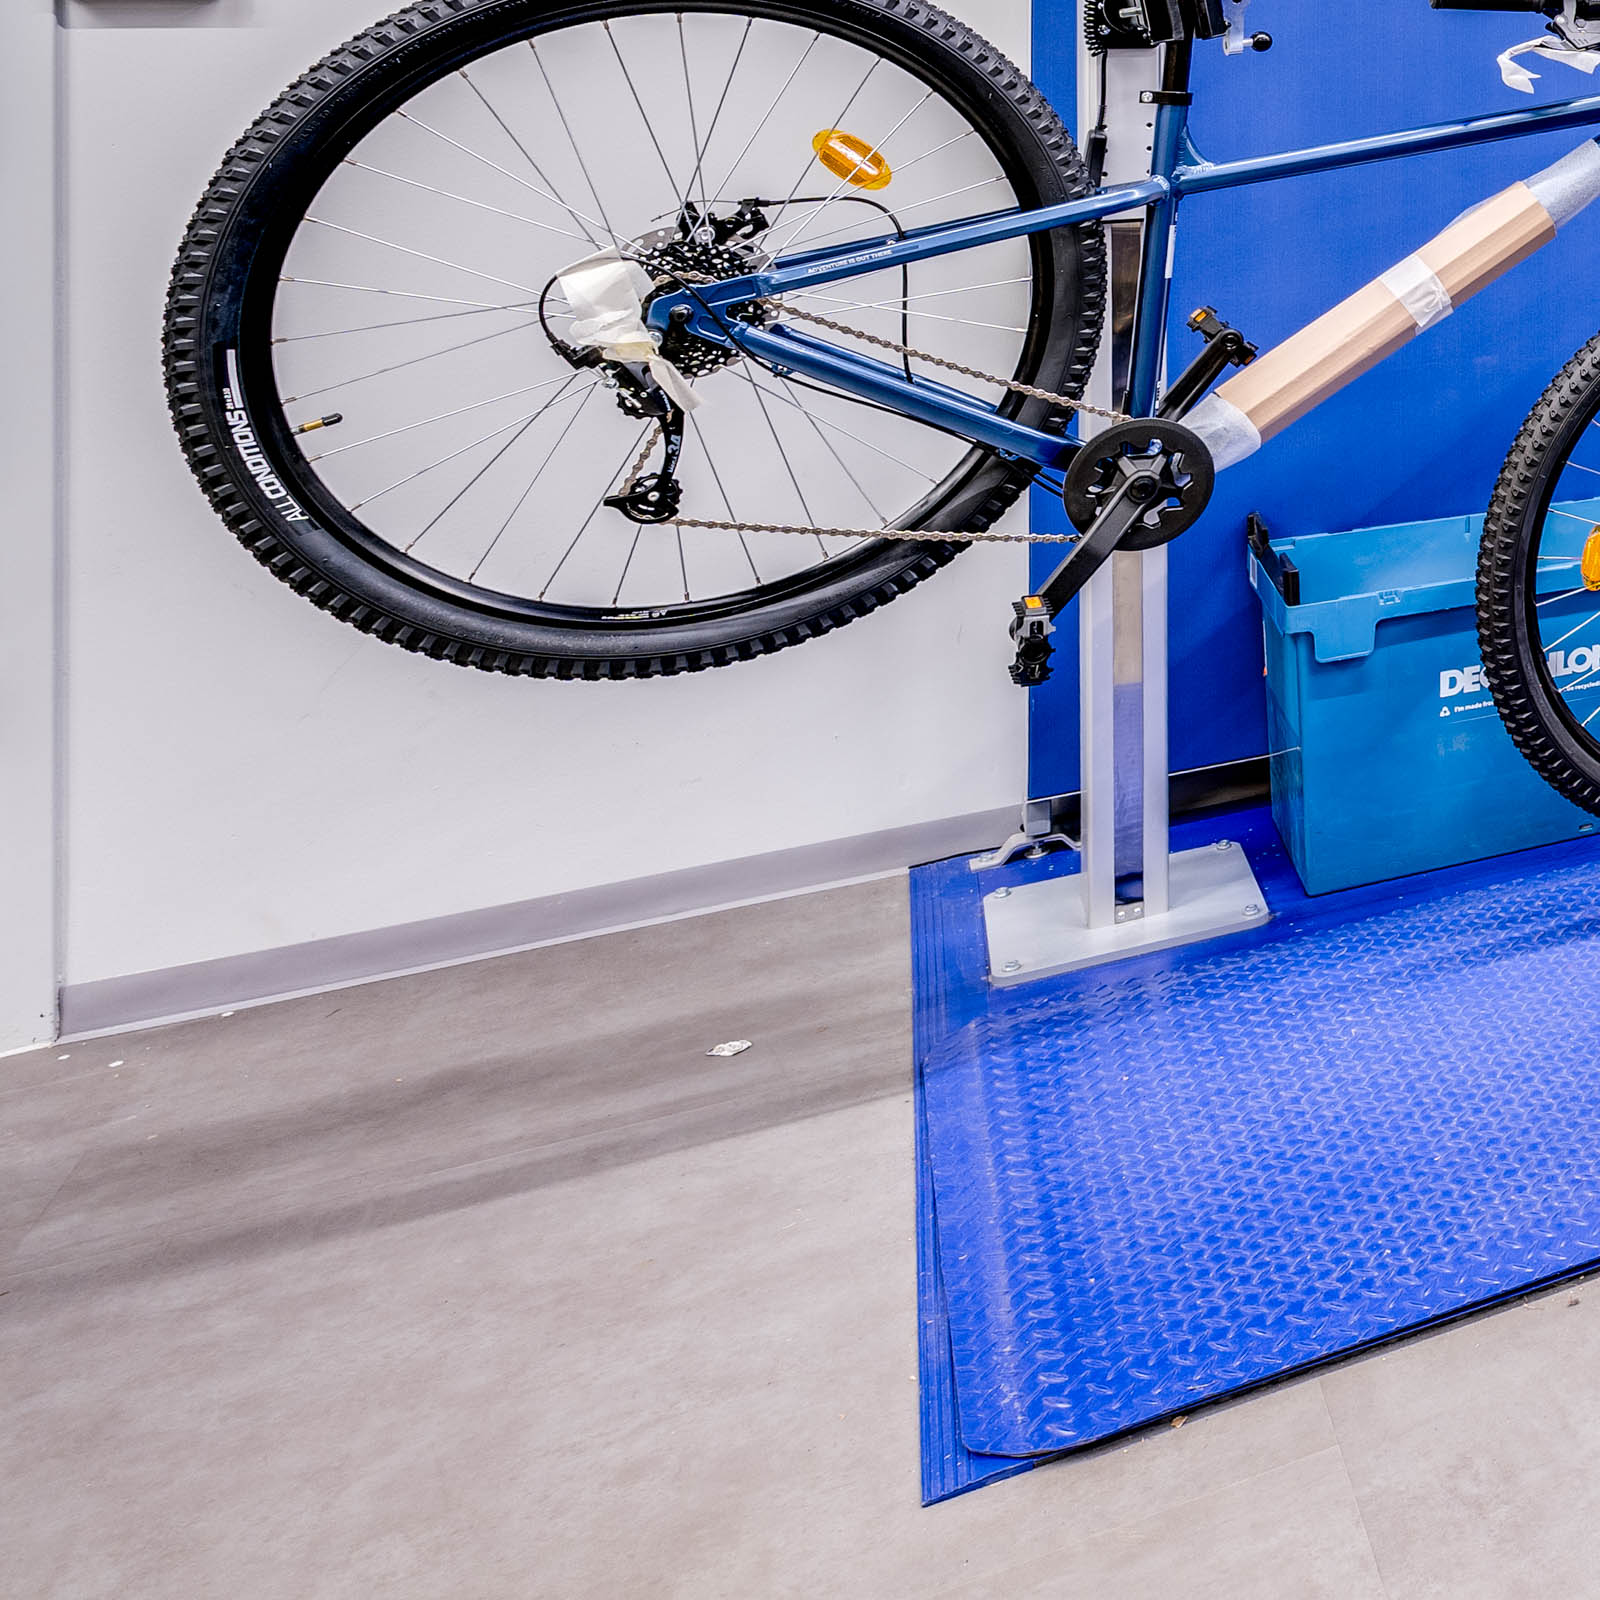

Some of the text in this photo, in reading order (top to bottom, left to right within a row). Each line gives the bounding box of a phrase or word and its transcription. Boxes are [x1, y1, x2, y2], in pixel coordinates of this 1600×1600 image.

[807, 259, 848, 274] ADVENTURE
[871, 249, 893, 260] THERE
[667, 434, 682, 455] 34
[225, 409, 309, 522] ALL CONDITIONS
[1465, 702, 1483, 711] made
